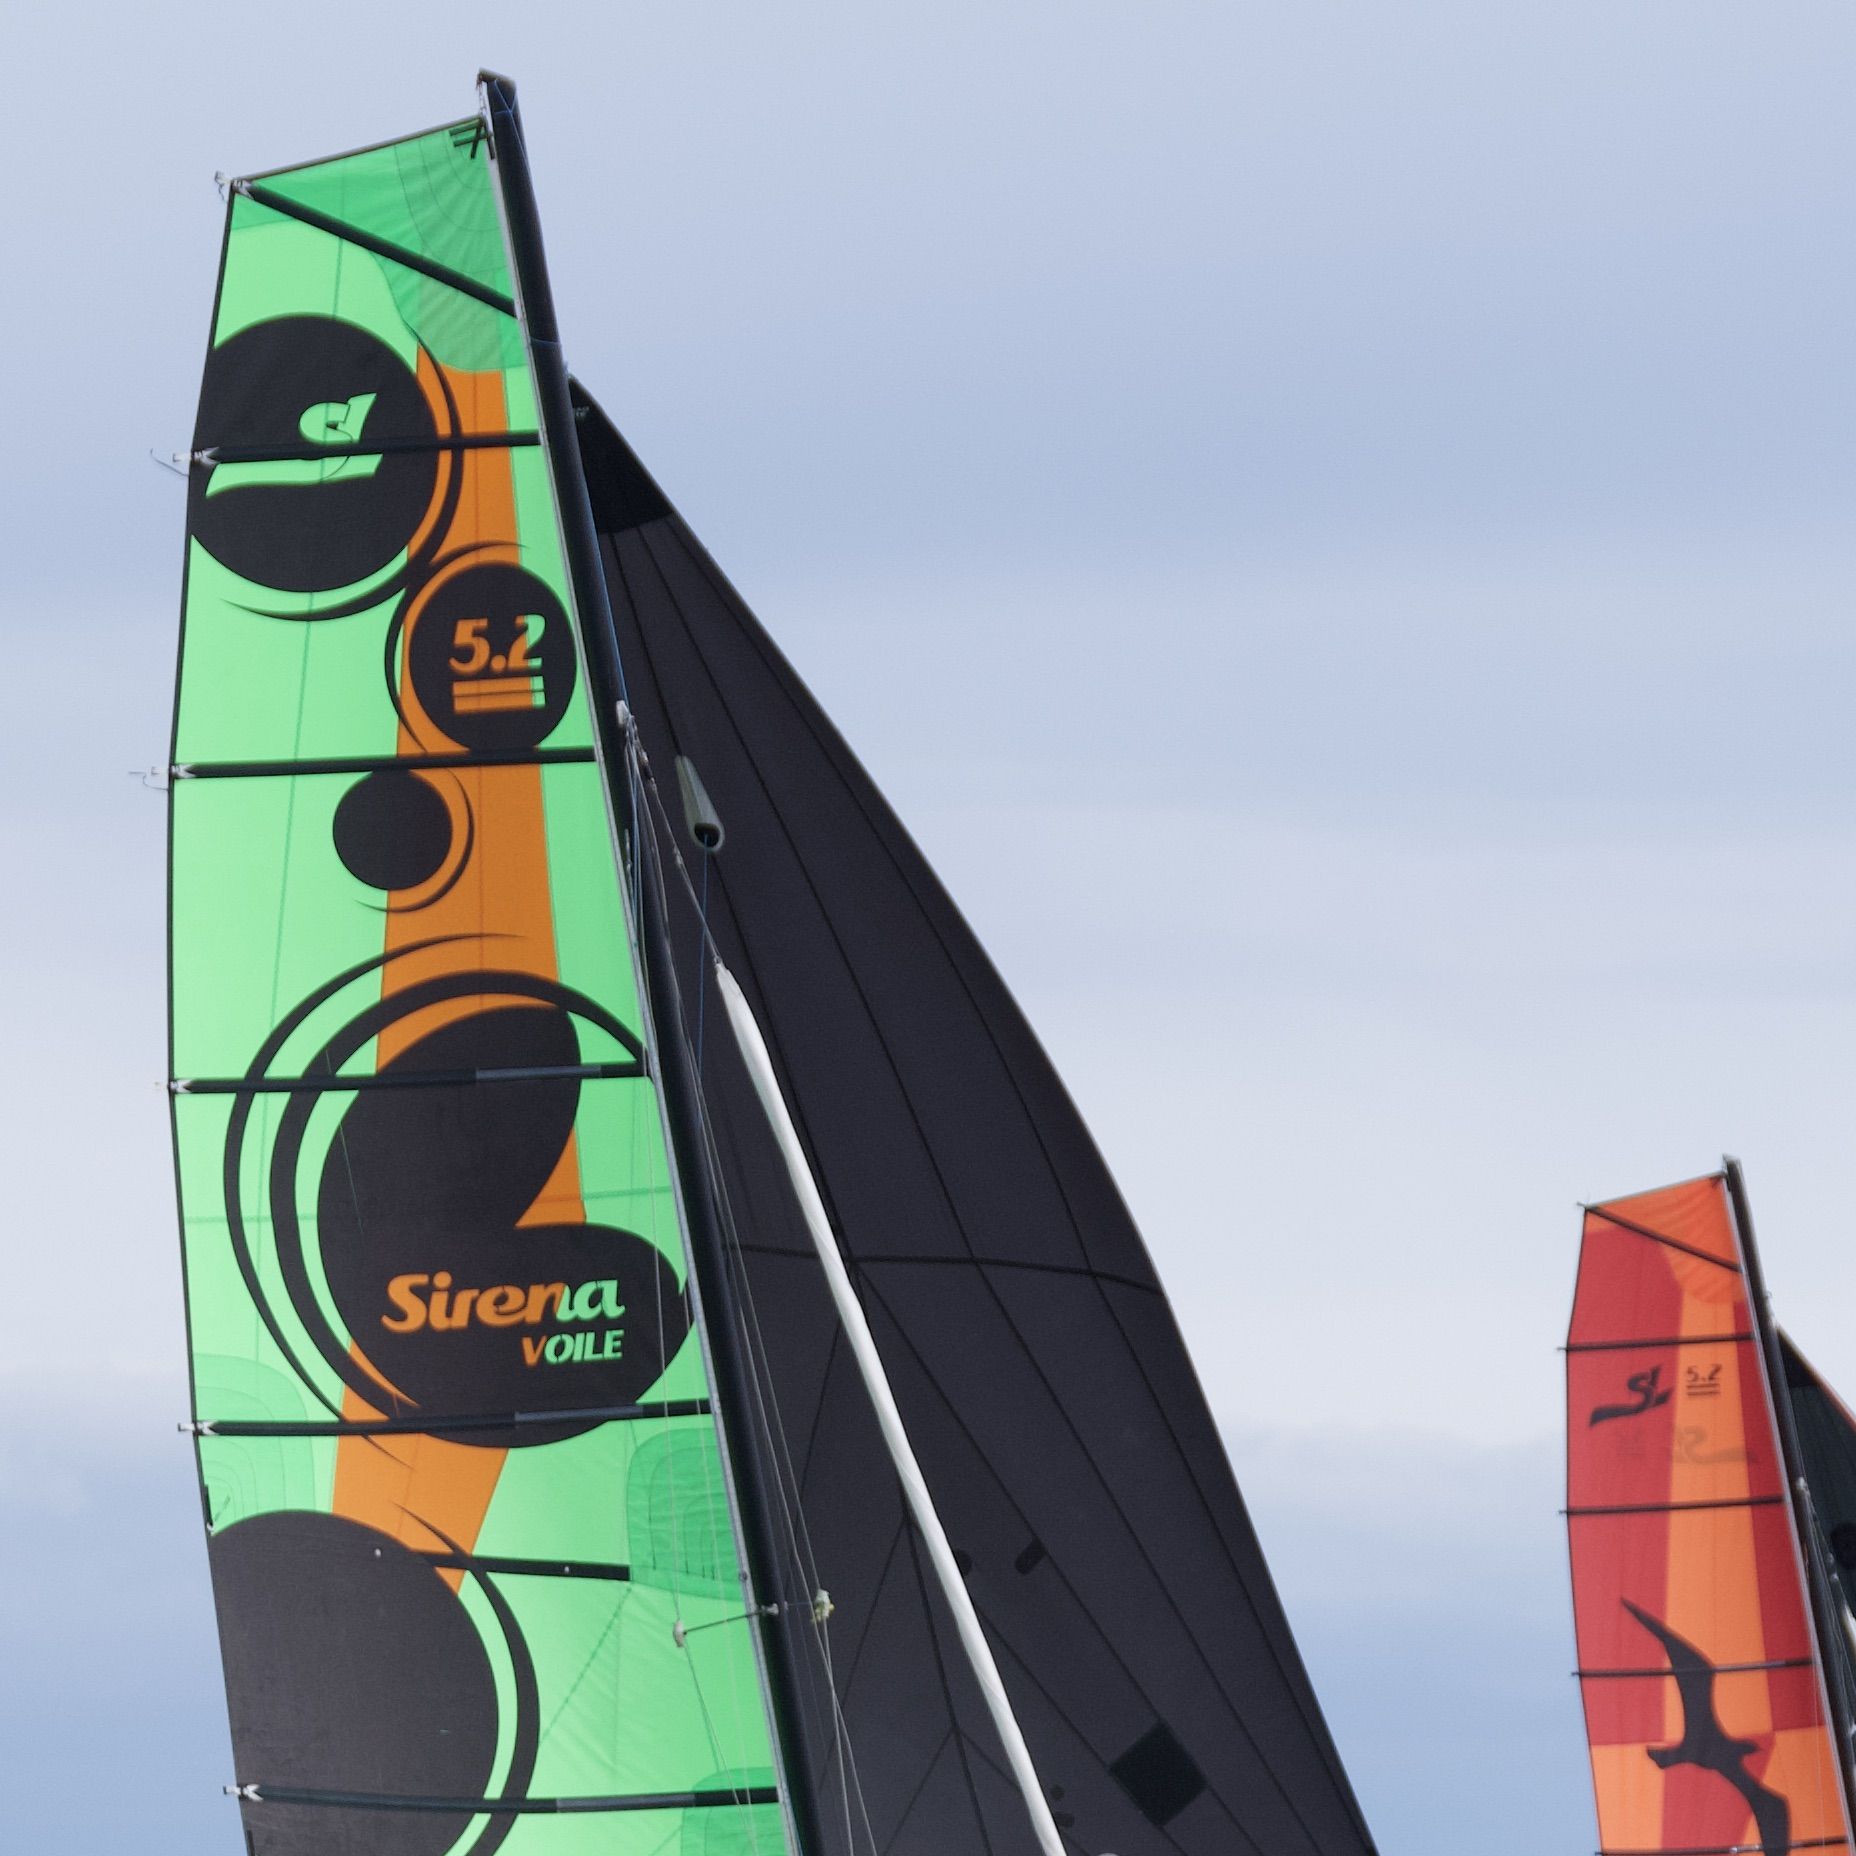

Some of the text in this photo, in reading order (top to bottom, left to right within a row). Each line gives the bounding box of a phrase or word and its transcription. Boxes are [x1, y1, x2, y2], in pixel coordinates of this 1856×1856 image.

[449, 613, 546, 674] 5.2
[381, 1270, 625, 1334] Sirena
[523, 1329, 624, 1366] VOILE
[1687, 1364, 1723, 1383] 5.2
